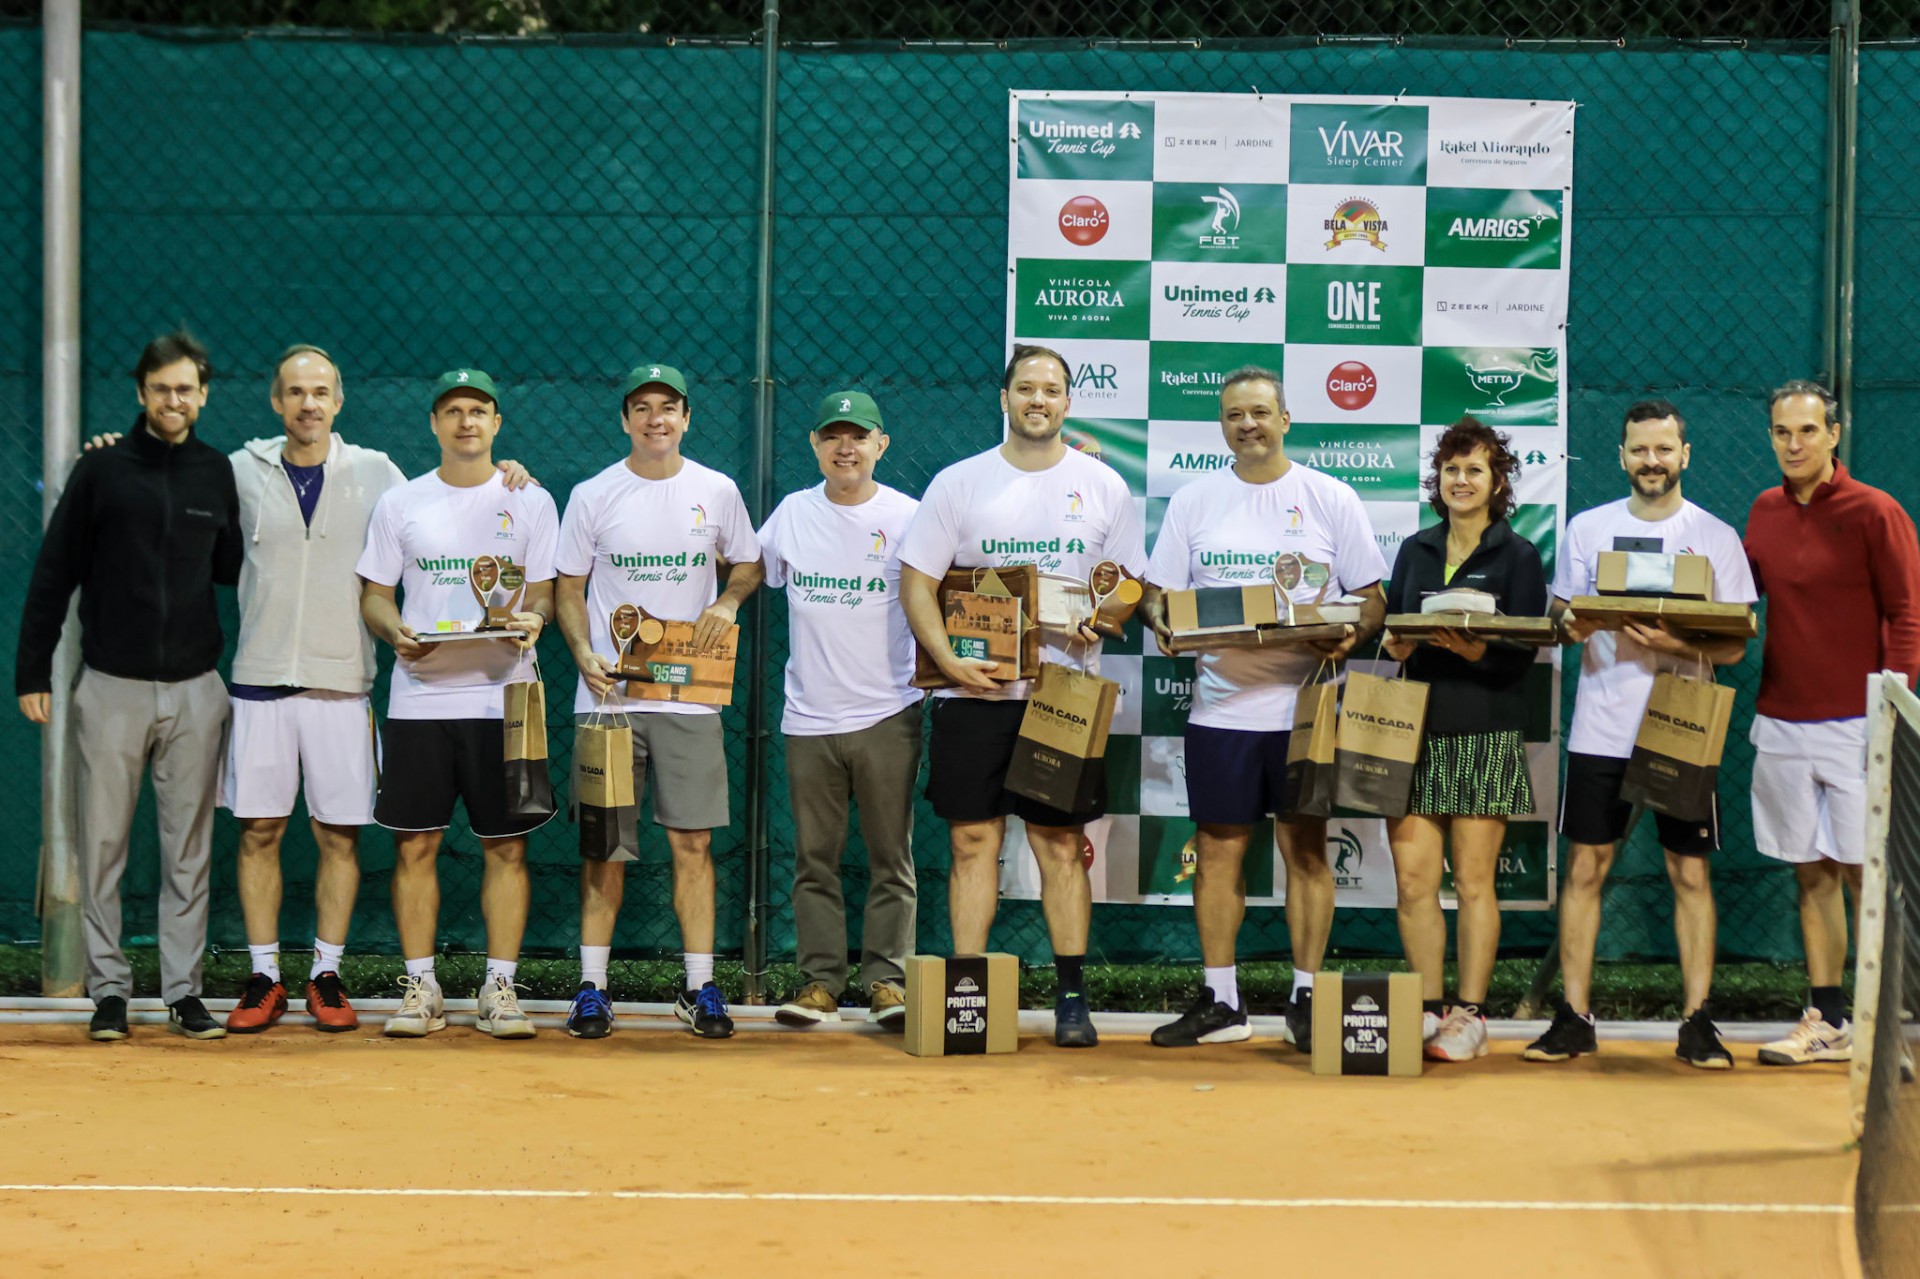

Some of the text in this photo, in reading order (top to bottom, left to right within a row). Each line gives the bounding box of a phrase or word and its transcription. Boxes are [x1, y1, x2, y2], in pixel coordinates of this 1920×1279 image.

[1029, 120, 1113, 139] Unimed
[1235, 138, 1274, 148] JARDINE
[1318, 121, 1404, 157] VIVAR
[1047, 139, 1116, 158] Tennis Cup
[1327, 157, 1403, 168] Sleep Center
[1062, 213, 1099, 228] Claro
[1324, 219, 1388, 231] BELA VISTA
[1448, 218, 1530, 238] AMRIGS
[1200, 236, 1239, 245] FGT
[1049, 277, 1111, 288] VINÍCOLA
[1035, 289, 1124, 307] AURORA
[1164, 285, 1248, 303] Unimed
[1183, 304, 1250, 323] Tennis Cup
[1506, 303, 1545, 312] JARDINE
[1071, 364, 1117, 389] VAR
[1478, 375, 1514, 384] METTA
[1182, 388, 1214, 396] Corretora
[1329, 379, 1367, 392] Claro
[1080, 389, 1117, 399] Center
[1319, 440, 1381, 449] VINÍCOLA
[1306, 452, 1395, 469] AURORA
[981, 537, 1060, 554] Unimed
[416, 555, 474, 571] Unime
[611, 552, 686, 567] Unimed
[1038, 555, 1062, 573] Cup
[432, 573, 467, 585] Tennis
[627, 568, 688, 586] Tennis Cup
[793, 571, 861, 591] Unimed
[1218, 567, 1254, 579] Tennis
[804, 590, 863, 610] Tennis Cup
[653, 664, 670, 682] 95
[1032, 699, 1087, 726] VIVA CADA
[1346, 710, 1414, 731] VIVA CADA
[1648, 708, 1705, 734] VIVA CADA
[1335, 877, 1362, 886] GT
[947, 996, 986, 1008] PROTEIN
[1344, 1015, 1387, 1027] PROTEIN
